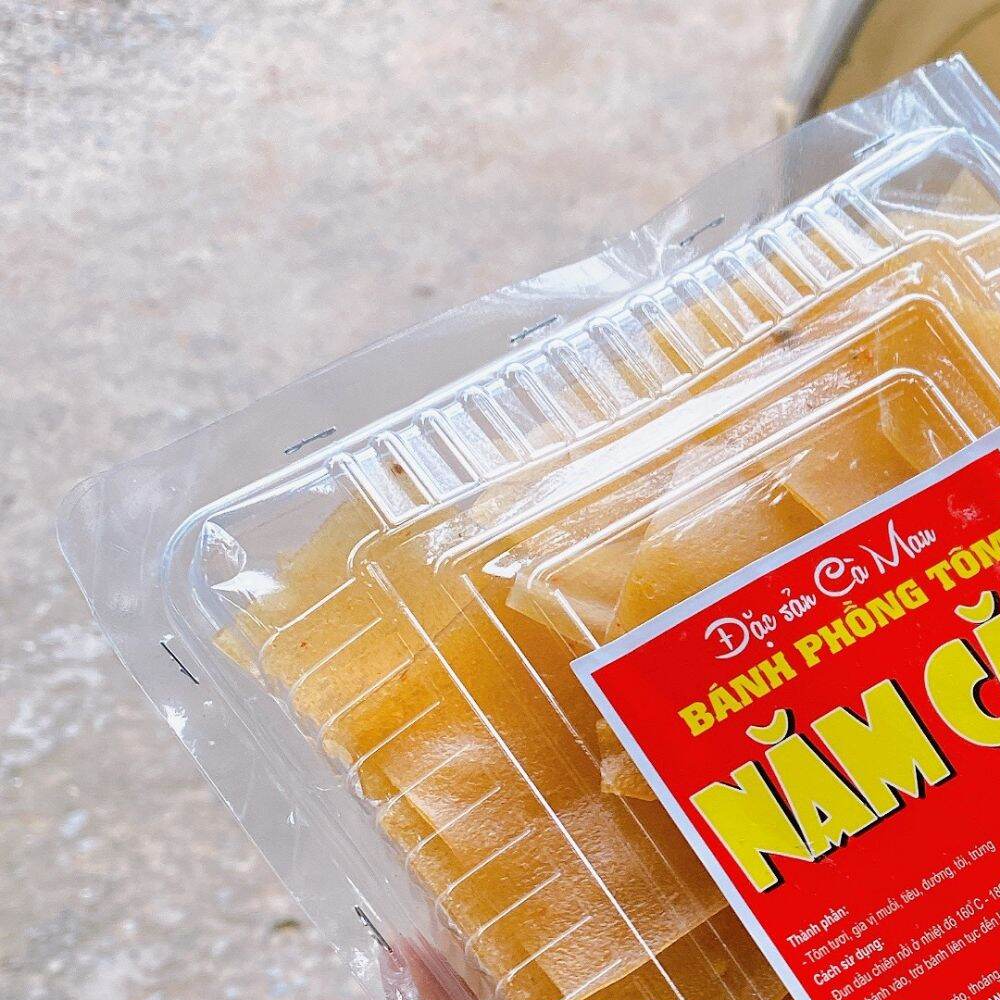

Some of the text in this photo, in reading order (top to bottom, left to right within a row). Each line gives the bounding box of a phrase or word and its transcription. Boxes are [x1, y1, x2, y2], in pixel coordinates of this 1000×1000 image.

[705, 519, 936, 659] Đặc sản Cà Mau
[678, 651, 797, 736] BÁNH
[793, 579, 929, 668] PHỒNG
[689, 679, 951, 893] NĂM
[786, 906, 849, 947] Thành phần:
[805, 945, 830, 963] Tôm
[827, 933, 853, 950] tươi,
[852, 922, 868, 938] gia
[866, 915, 878, 925] vị
[876, 898, 903, 920] muối,
[900, 888, 923, 903] tiêu,
[922, 867, 956, 890] đường,
[968, 841, 996, 860] trứng
[813, 964, 841, 985] Cách
[855, 938, 884, 960] dụng:
[831, 984, 854, 1000] Đun
[853, 972, 872, 988] dầu
[872, 956, 897, 976] chiên
[920, 924, 945, 945] nhiệt
[943, 916, 957, 930] độ
[889, 977, 911, 992] vào,
[922, 949, 949, 970] bánh
[946, 939, 966, 955] liên
[964, 929, 981, 943] tục
[980, 917, 999, 934] đến
